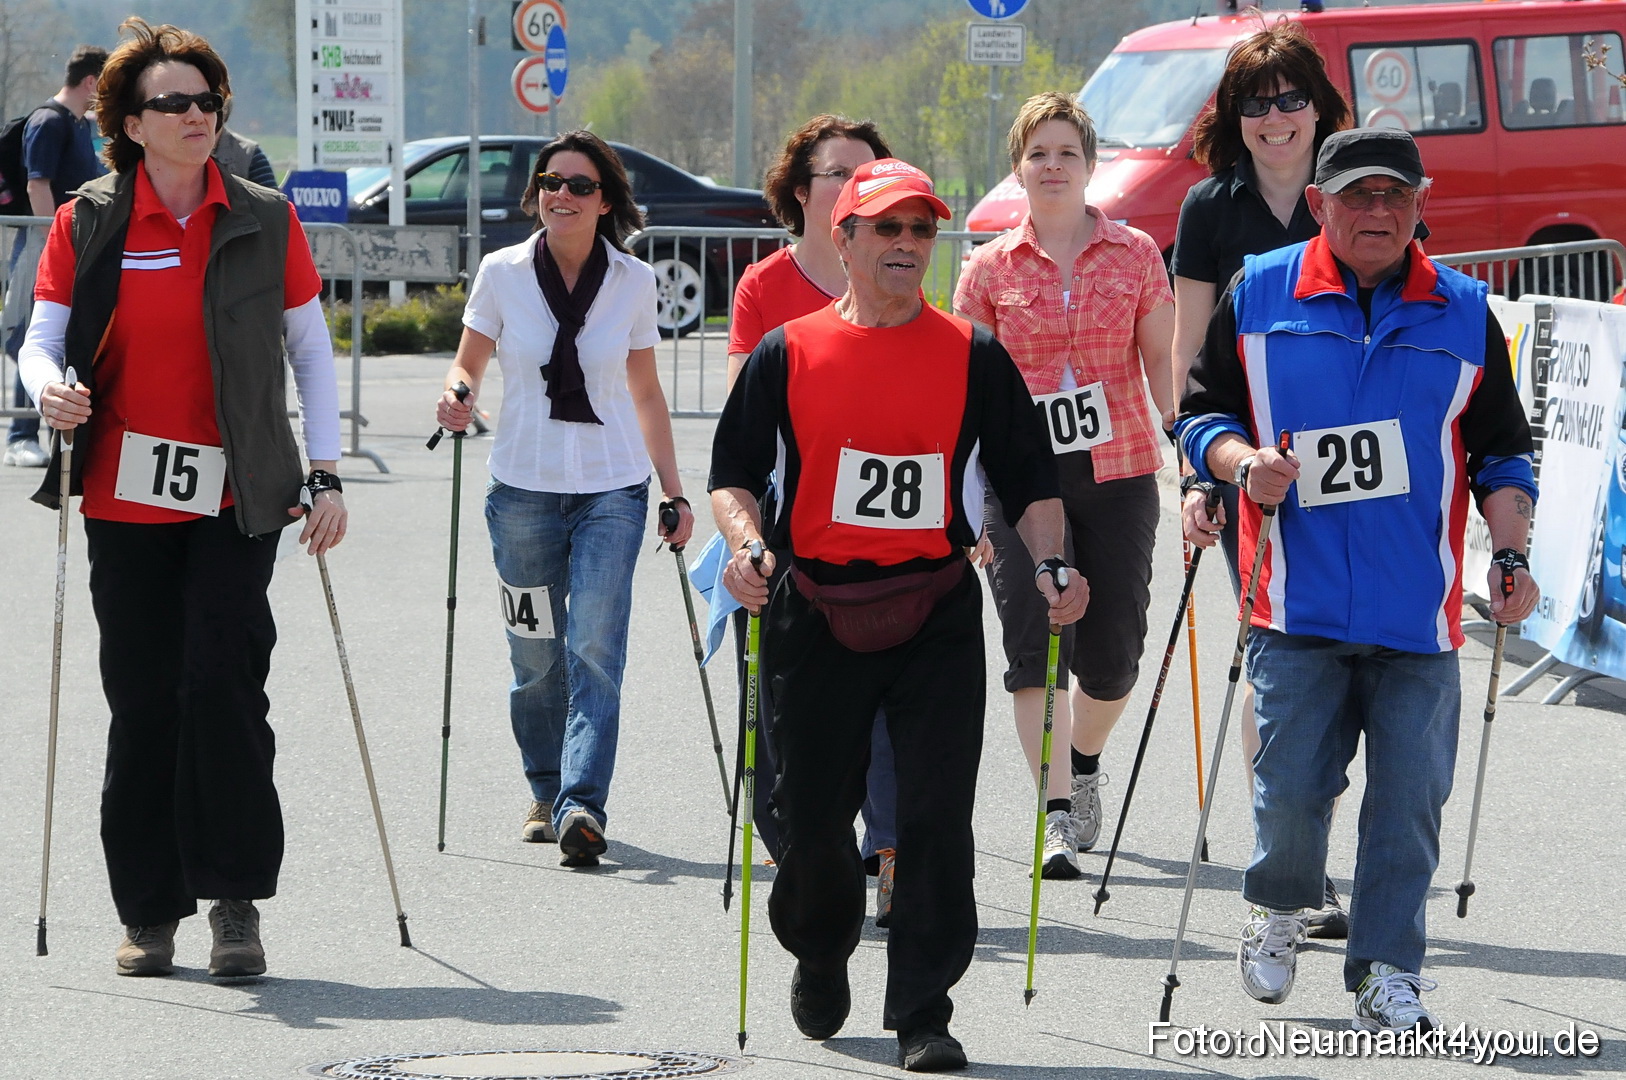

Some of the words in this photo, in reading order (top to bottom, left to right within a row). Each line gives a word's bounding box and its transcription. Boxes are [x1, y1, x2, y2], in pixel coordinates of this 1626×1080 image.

[321, 45, 342, 68] SHB
[1376, 65, 1402, 88] 60
[322, 110, 355, 131] THULE
[291, 187, 341, 208] VOLVO
[152, 442, 200, 501] 15
[1317, 429, 1383, 495] 29
[856, 458, 922, 519] 28
[499, 583, 539, 632] 04
[746, 674, 757, 722] MANIA
[1046, 684, 1057, 724] MANIA
